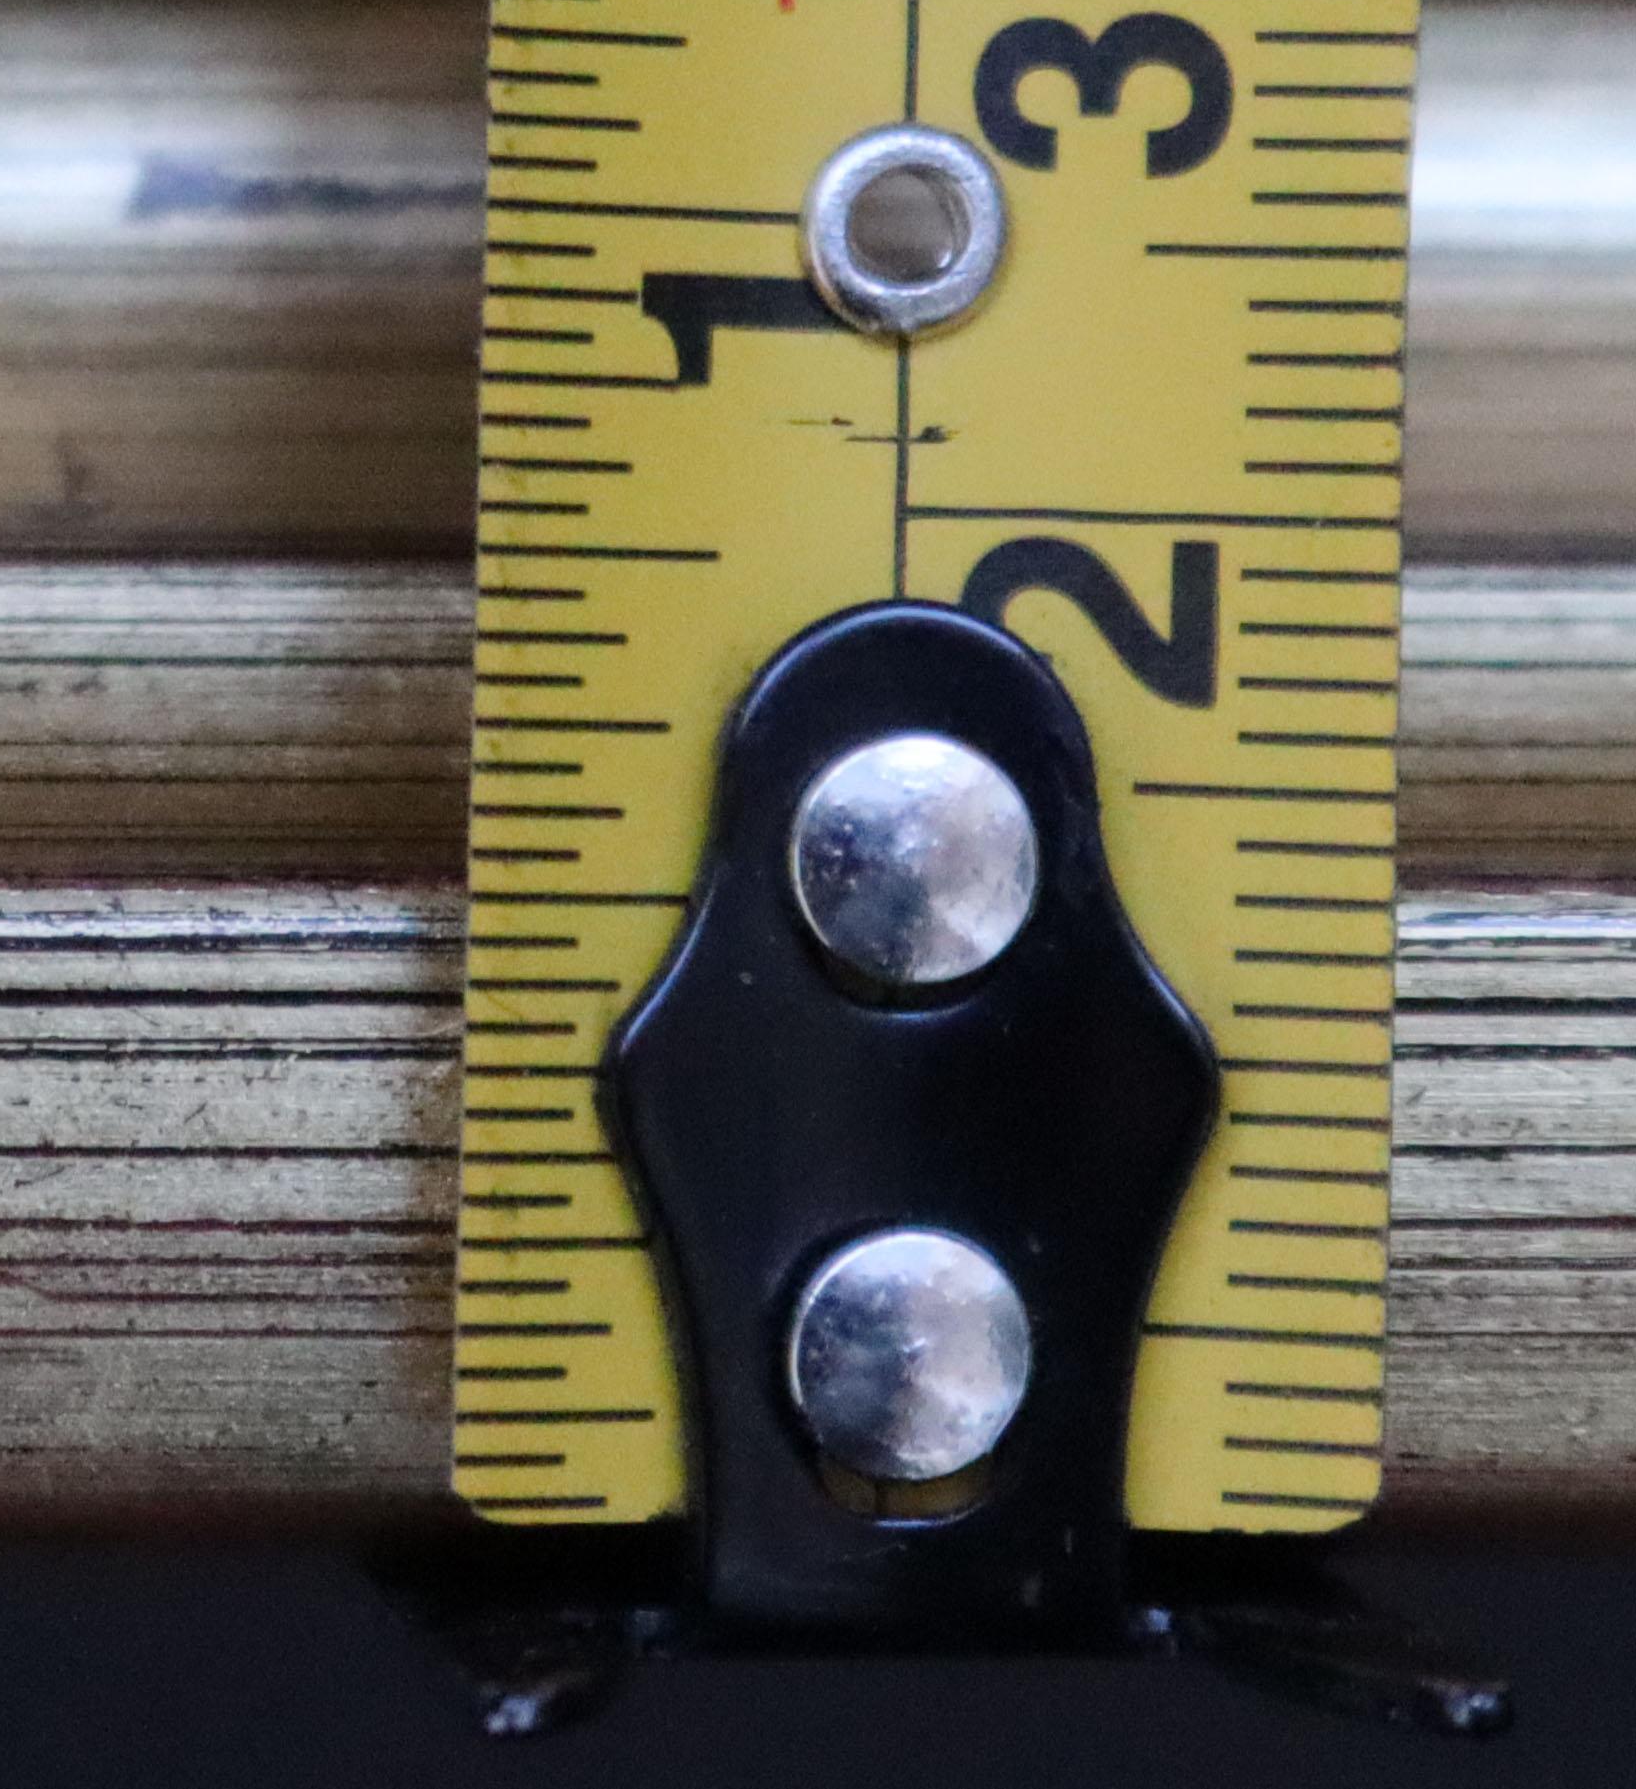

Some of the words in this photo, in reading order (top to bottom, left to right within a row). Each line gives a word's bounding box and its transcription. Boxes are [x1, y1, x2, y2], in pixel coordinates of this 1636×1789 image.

[973, 12, 1235, 180] 3
[640, 271, 843, 387] 1
[960, 534, 1221, 709] 2
